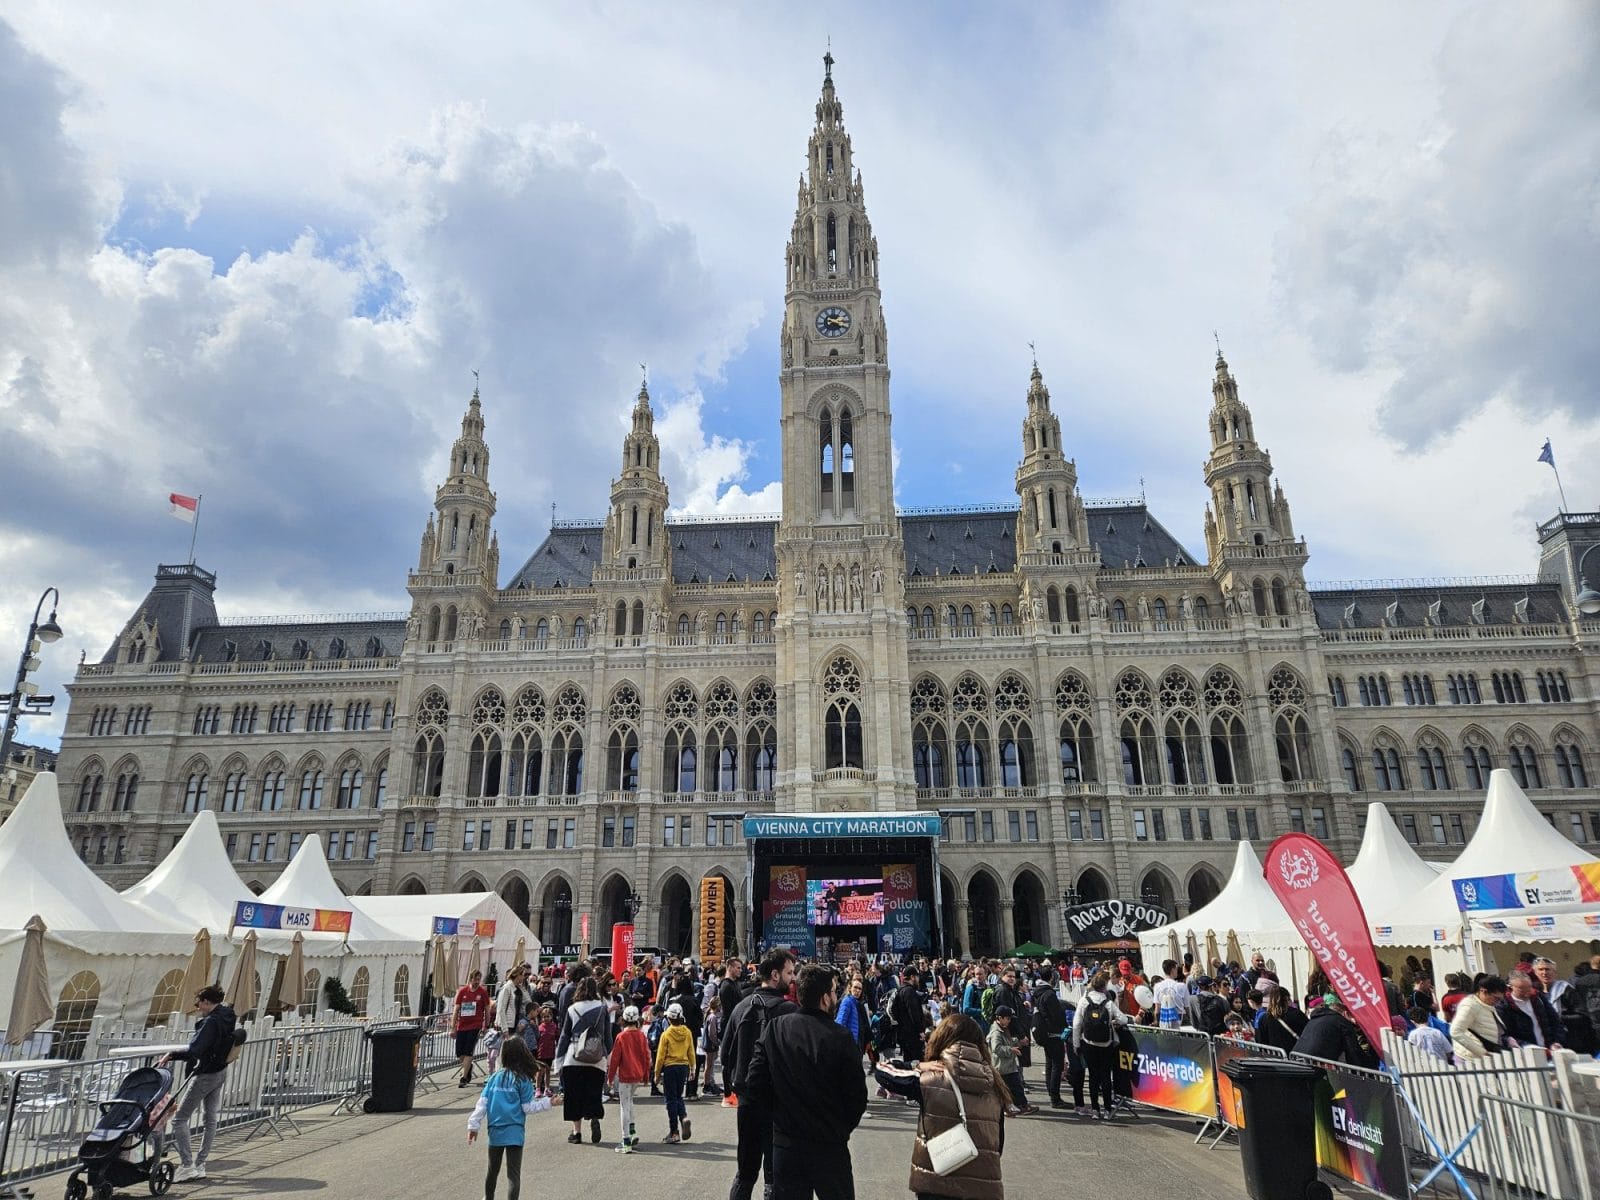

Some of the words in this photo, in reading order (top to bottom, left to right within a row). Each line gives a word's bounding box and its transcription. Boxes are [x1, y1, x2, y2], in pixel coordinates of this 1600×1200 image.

[755, 822, 808, 834] VIENNA
[812, 821, 843, 834] CITY
[847, 820, 927, 834] MARATHON
[707, 881, 718, 914] WIEN
[883, 897, 923, 909] Follow
[1525, 888, 1541, 905] EY
[286, 912, 310, 926] MARS
[895, 913, 911, 923] us
[1070, 905, 1110, 932] ROCK
[1125, 903, 1168, 928] FOOD
[706, 916, 717, 957] RADIO
[1118, 1050, 1205, 1084] EY-Zielgerade
[1331, 1105, 1346, 1132] EY
[1347, 1117, 1384, 1146] denkstatt
